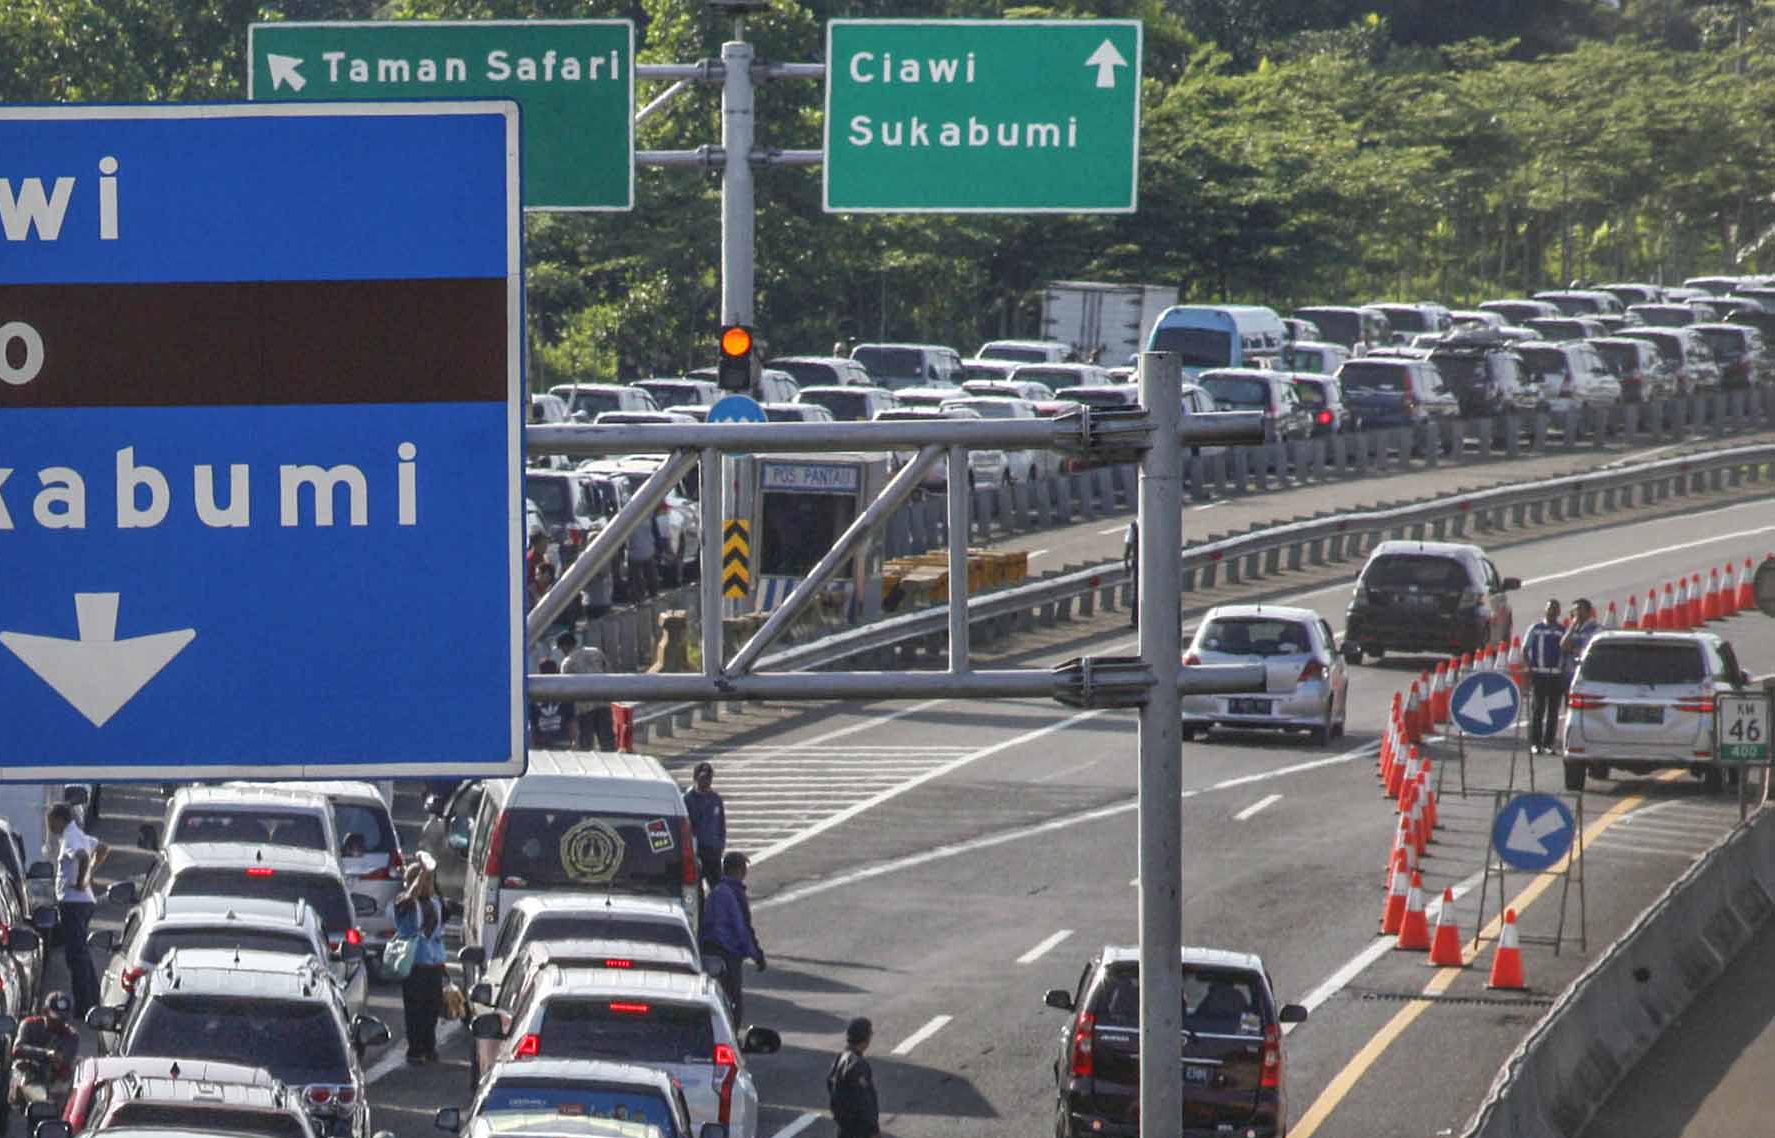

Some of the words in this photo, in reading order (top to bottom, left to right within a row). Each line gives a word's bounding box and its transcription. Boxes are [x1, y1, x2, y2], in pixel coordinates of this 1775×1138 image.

[323, 52, 466, 82] Taman
[487, 50, 618, 81] Safari
[849, 51, 975, 83] Ciawi
[848, 115, 1077, 147] Sukabumi
[1737, 703, 1755, 716] KM
[1729, 718, 1760, 742] 46
